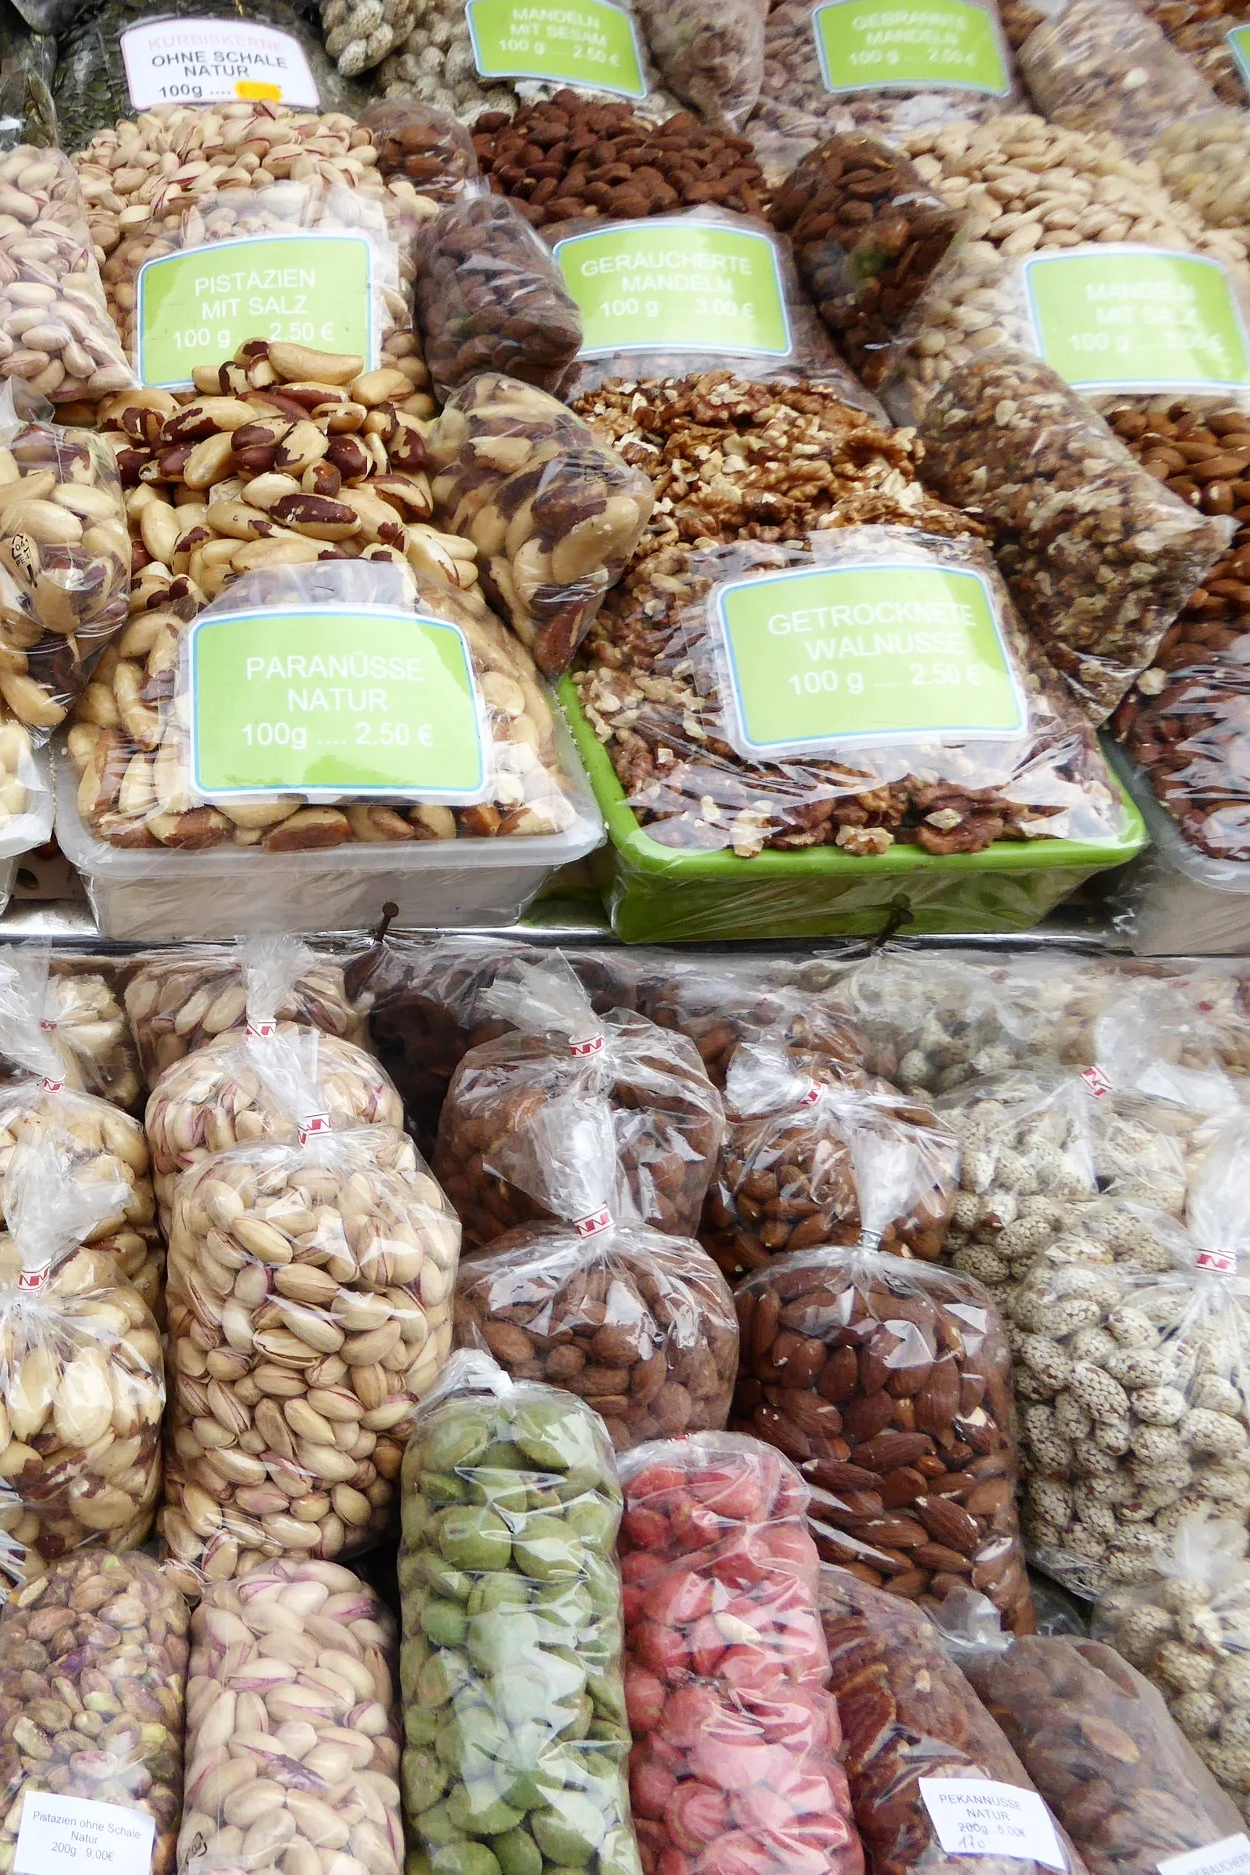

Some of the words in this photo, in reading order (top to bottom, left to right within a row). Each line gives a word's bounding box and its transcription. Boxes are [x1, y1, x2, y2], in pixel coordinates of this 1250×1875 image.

[501, 39, 529, 52] 100
[151, 51, 206, 67] OHNE
[213, 51, 288, 69] SCHALE
[184, 64, 250, 77] NATUR
[159, 83, 203, 98] 100g
[195, 269, 315, 296] PISTAZIEN
[622, 274, 733, 293] MANDELN
[202, 298, 240, 320] MIT
[249, 295, 308, 315] SALZ
[601, 299, 638, 317] 100
[645, 301, 659, 318] g
[173, 328, 210, 349] 100
[217, 330, 230, 348] g
[270, 322, 314, 341] 2.50
[321, 323, 334, 341] €
[768, 601, 977, 635] GETROCKNETE
[805, 629, 966, 662] WALNÜSSE
[246, 651, 424, 682] PARANÜSSE
[789, 670, 839, 696] 100
[847, 672, 864, 694] g
[909, 662, 961, 686] 2.50
[966, 664, 983, 687] €
[287, 688, 388, 712] NATUR
[241, 722, 307, 750] 100g
[355, 722, 410, 746] 2.50
[417, 724, 434, 747] €
[32, 1810, 77, 1827] Pistazien
[79, 1819, 104, 1832] ohne
[108, 1823, 141, 1840] Schale
[966, 1808, 1010, 1821] NATUR
[71, 1830, 98, 1845] Natur
